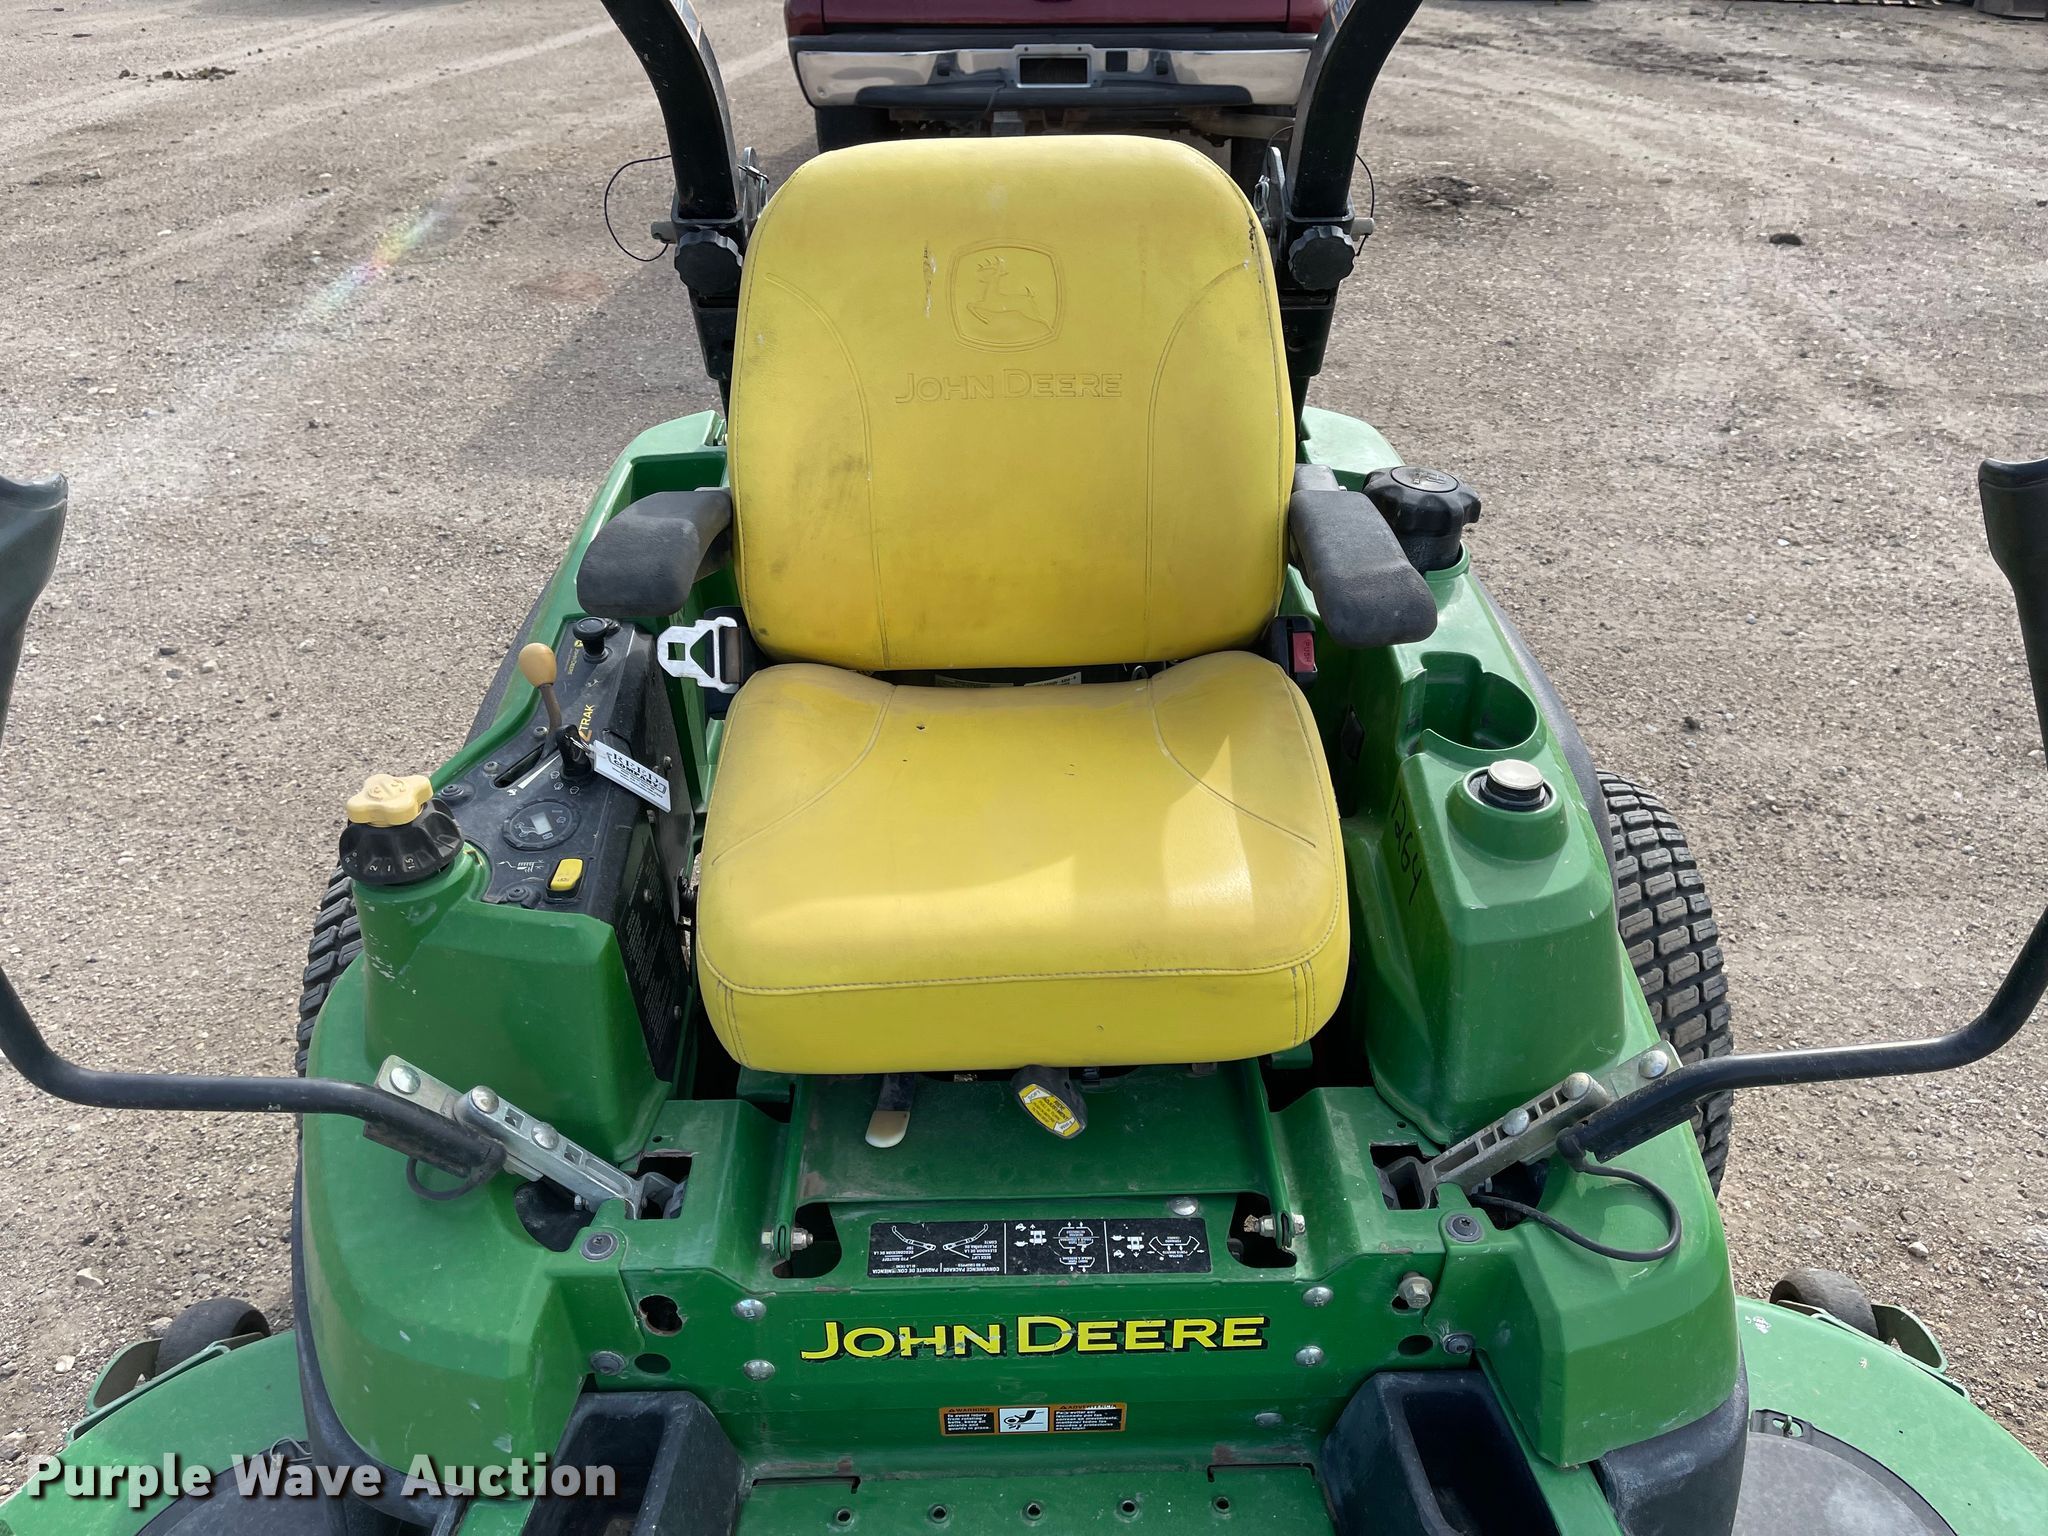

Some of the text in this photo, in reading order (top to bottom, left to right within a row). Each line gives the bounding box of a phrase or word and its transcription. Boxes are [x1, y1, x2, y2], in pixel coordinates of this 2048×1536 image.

[895, 368, 1122, 404] JOHN DEERE
[613, 752, 659, 783] REED
[613, 760, 659, 788] COMPANY
[799, 1315, 1267, 1362] JOHN DEERE
